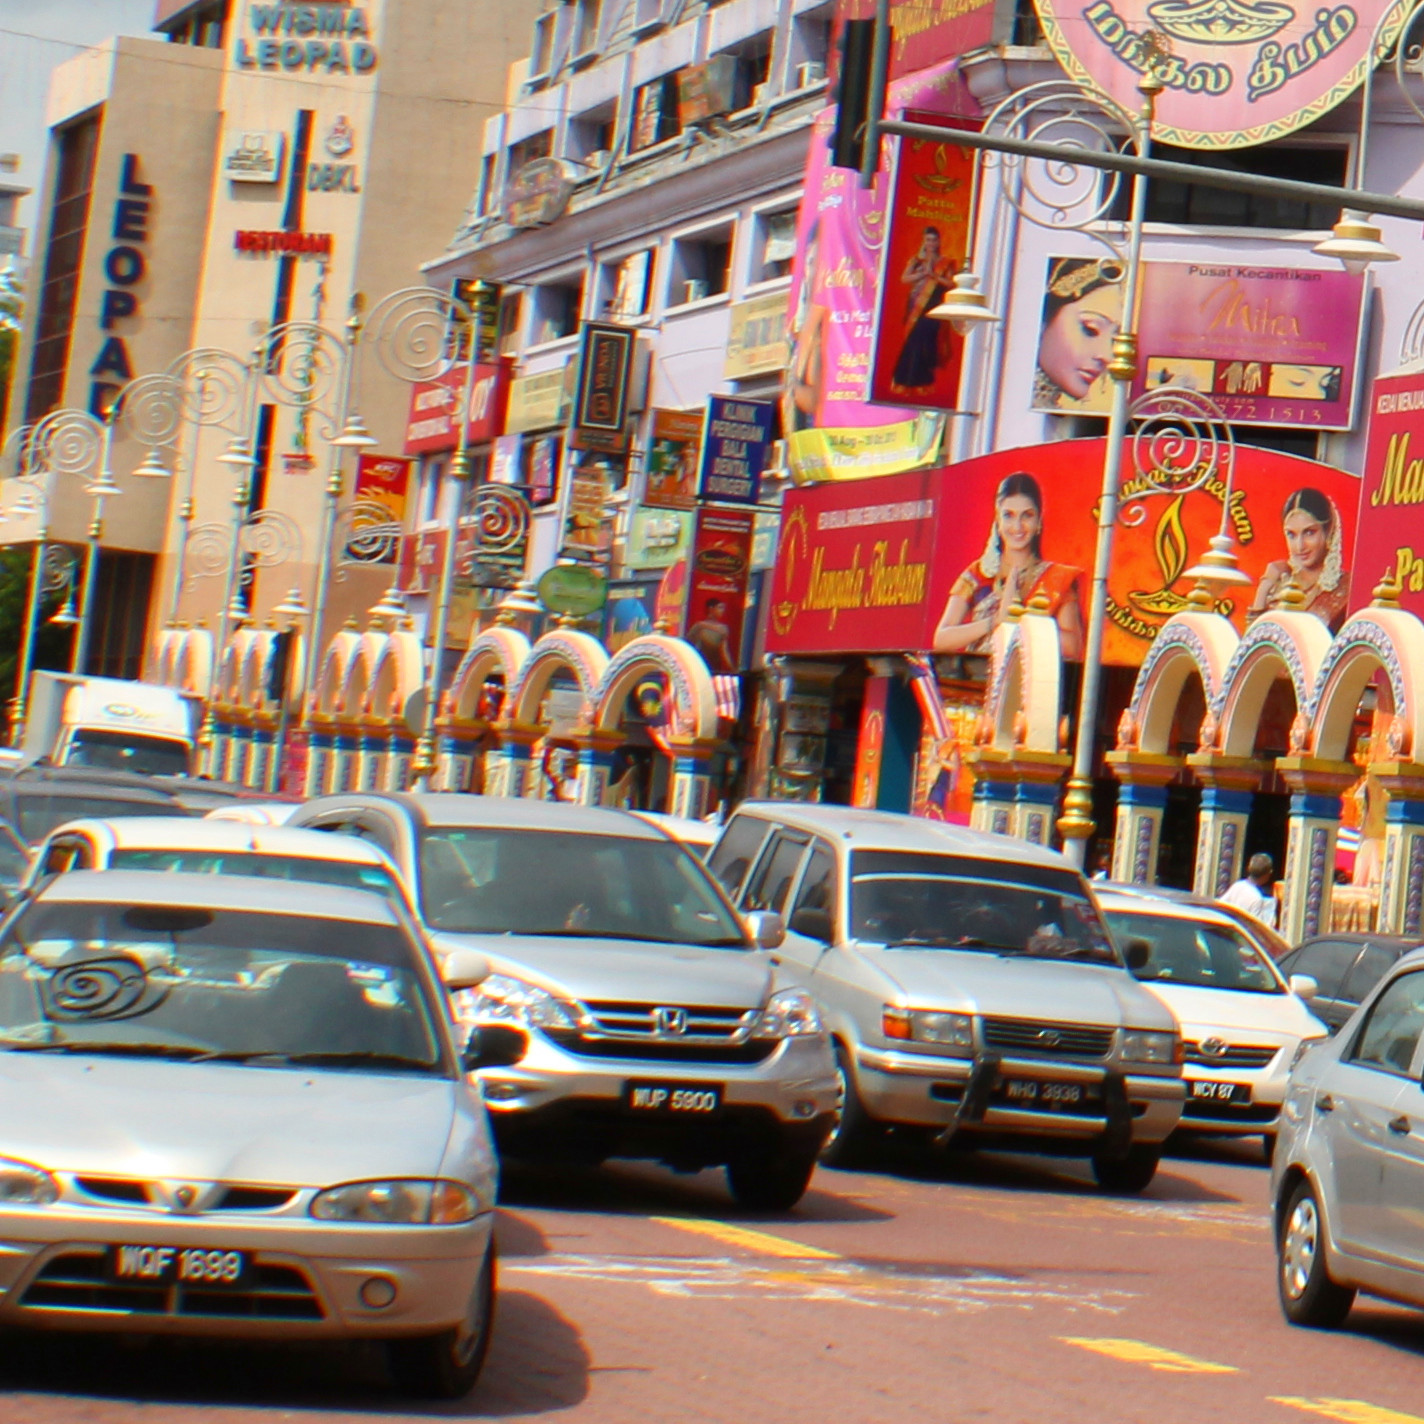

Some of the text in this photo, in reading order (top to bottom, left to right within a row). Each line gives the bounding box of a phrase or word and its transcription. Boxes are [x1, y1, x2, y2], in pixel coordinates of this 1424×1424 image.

[250, 4, 368, 35] WISMA
[236, 38, 379, 72] LEOPAD
[1188, 265, 1322, 281] Pusat Kecantikan
[88, 152, 155, 426] LEOPAD
[722, 402, 758, 422] KLINIK
[721, 441, 748, 459] BALA
[713, 458, 750, 477] DENTAL
[707, 476, 753, 497] SURGERY
